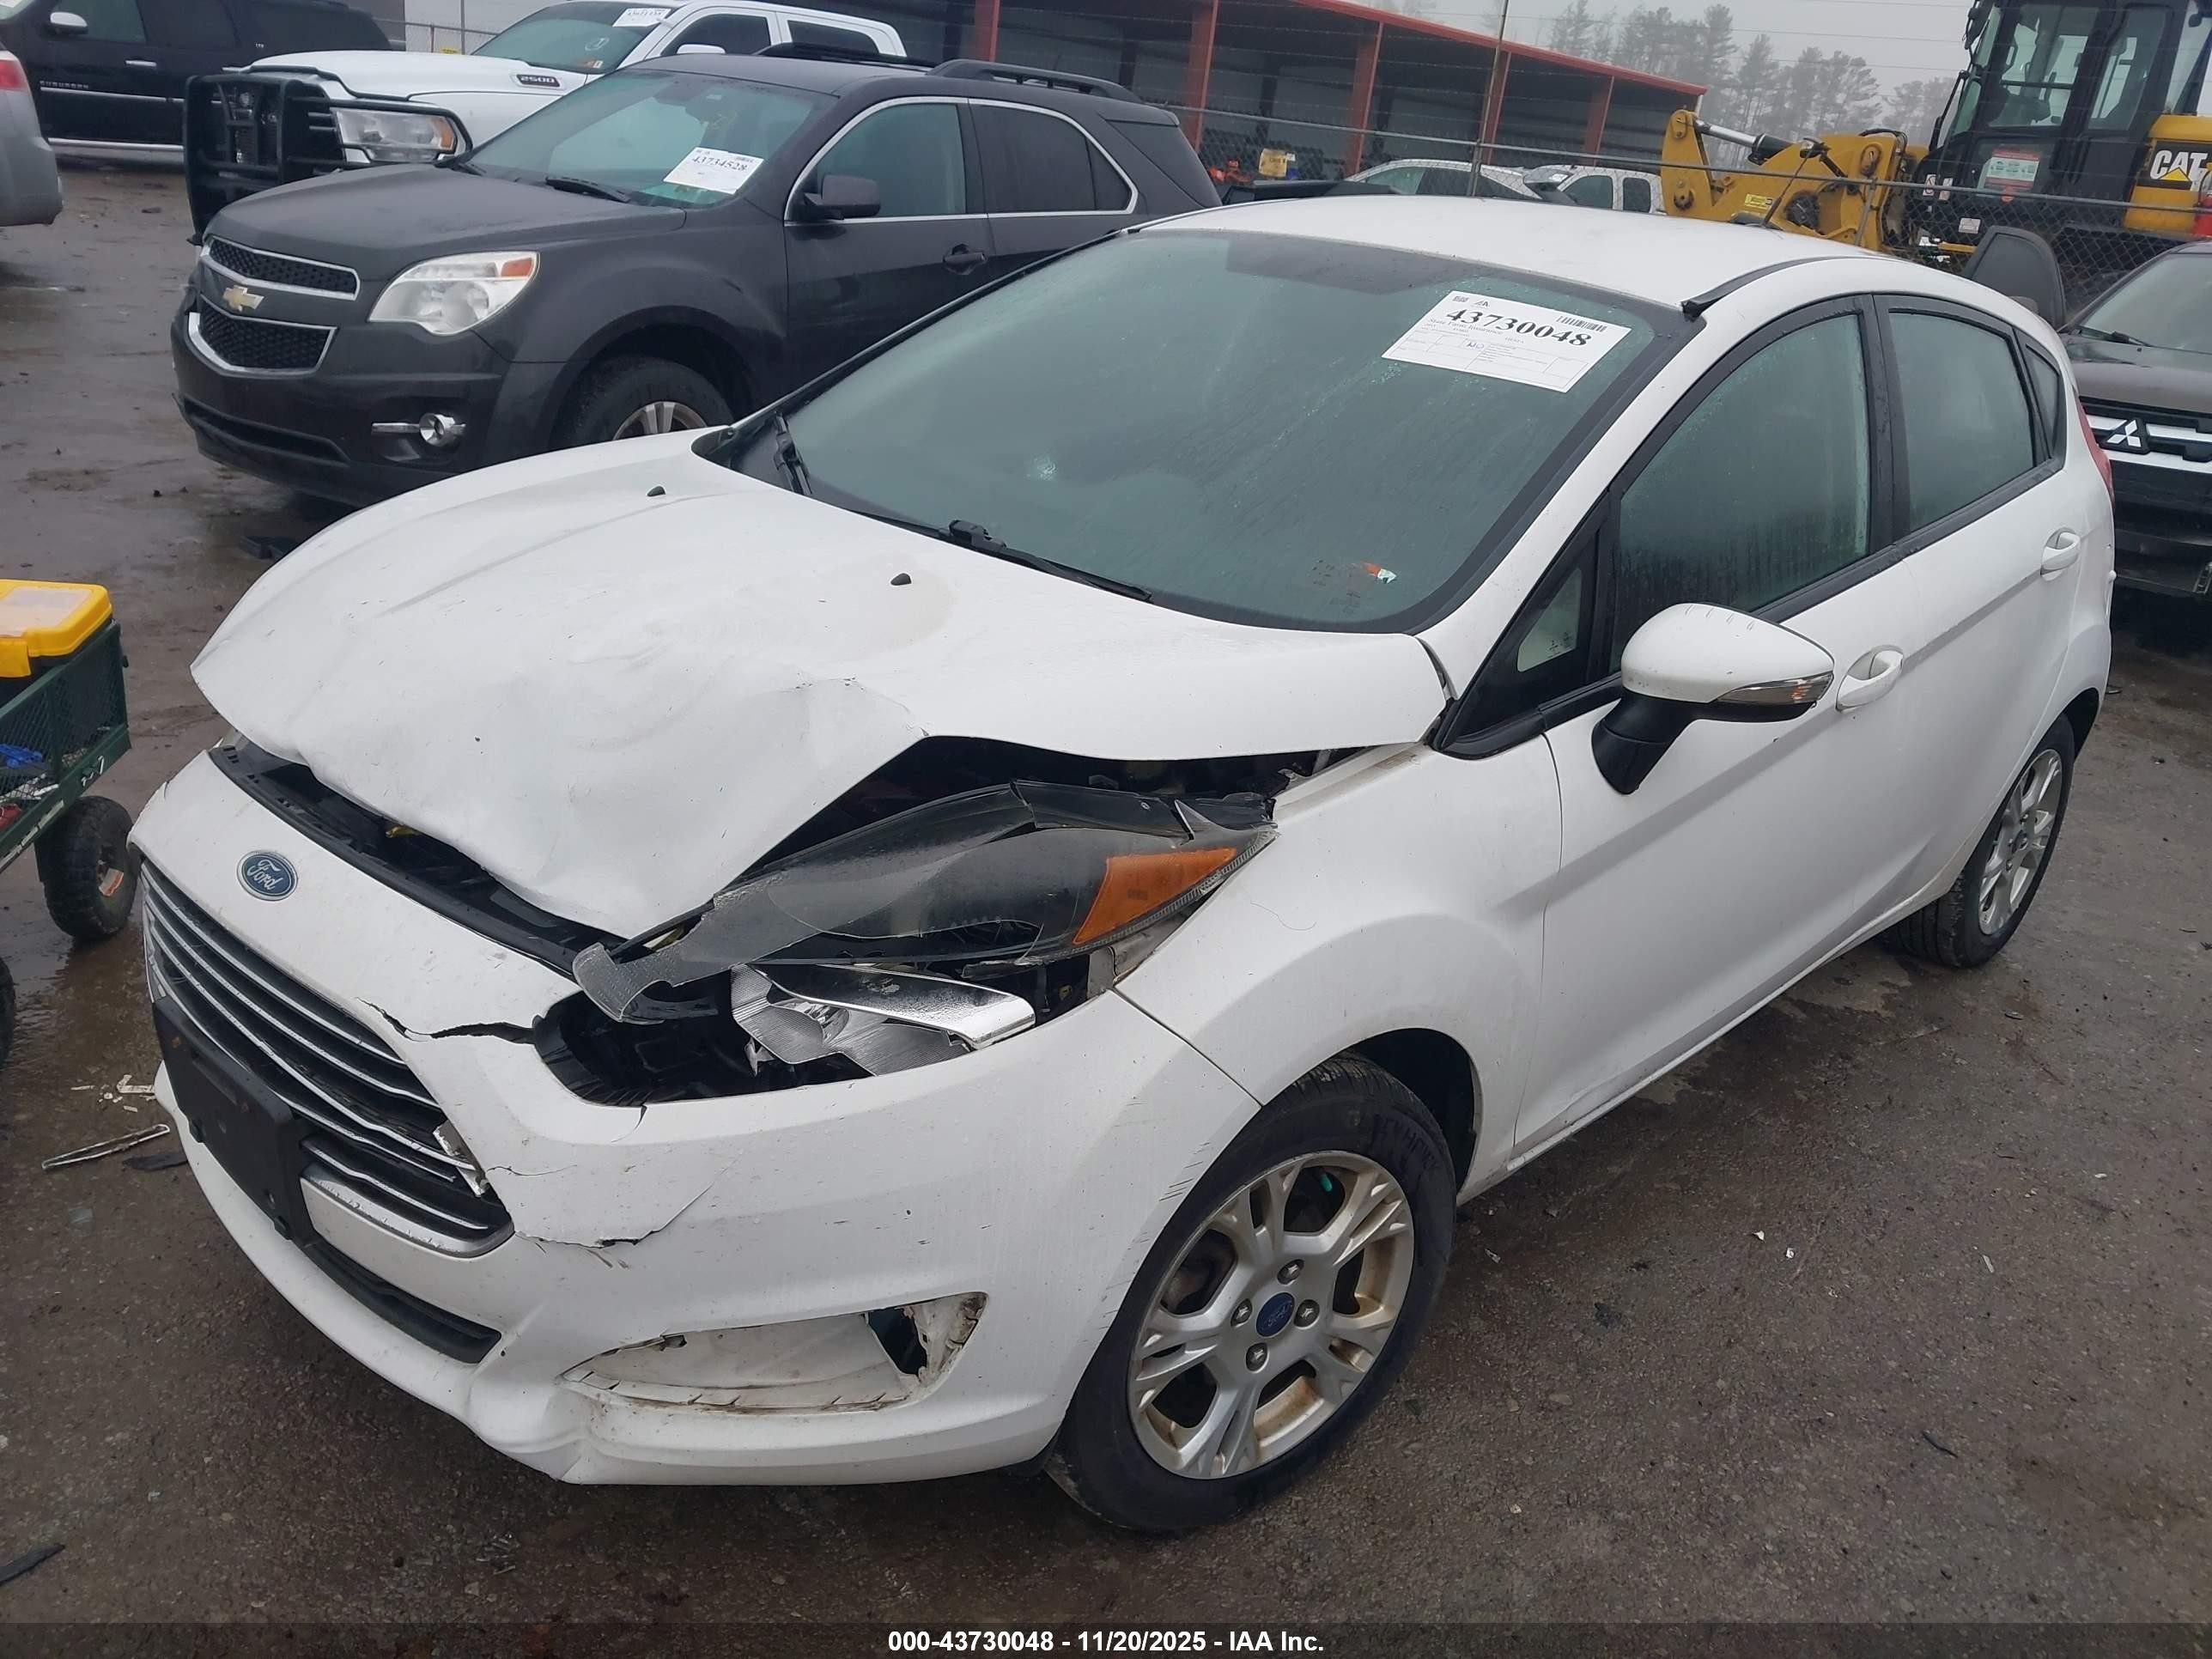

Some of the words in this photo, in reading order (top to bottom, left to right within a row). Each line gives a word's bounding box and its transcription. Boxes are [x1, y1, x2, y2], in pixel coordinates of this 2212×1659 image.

[2149, 149, 2209, 182] CAT
[1446, 308, 1592, 346] 43730048
[246, 859, 283, 890] Ford
